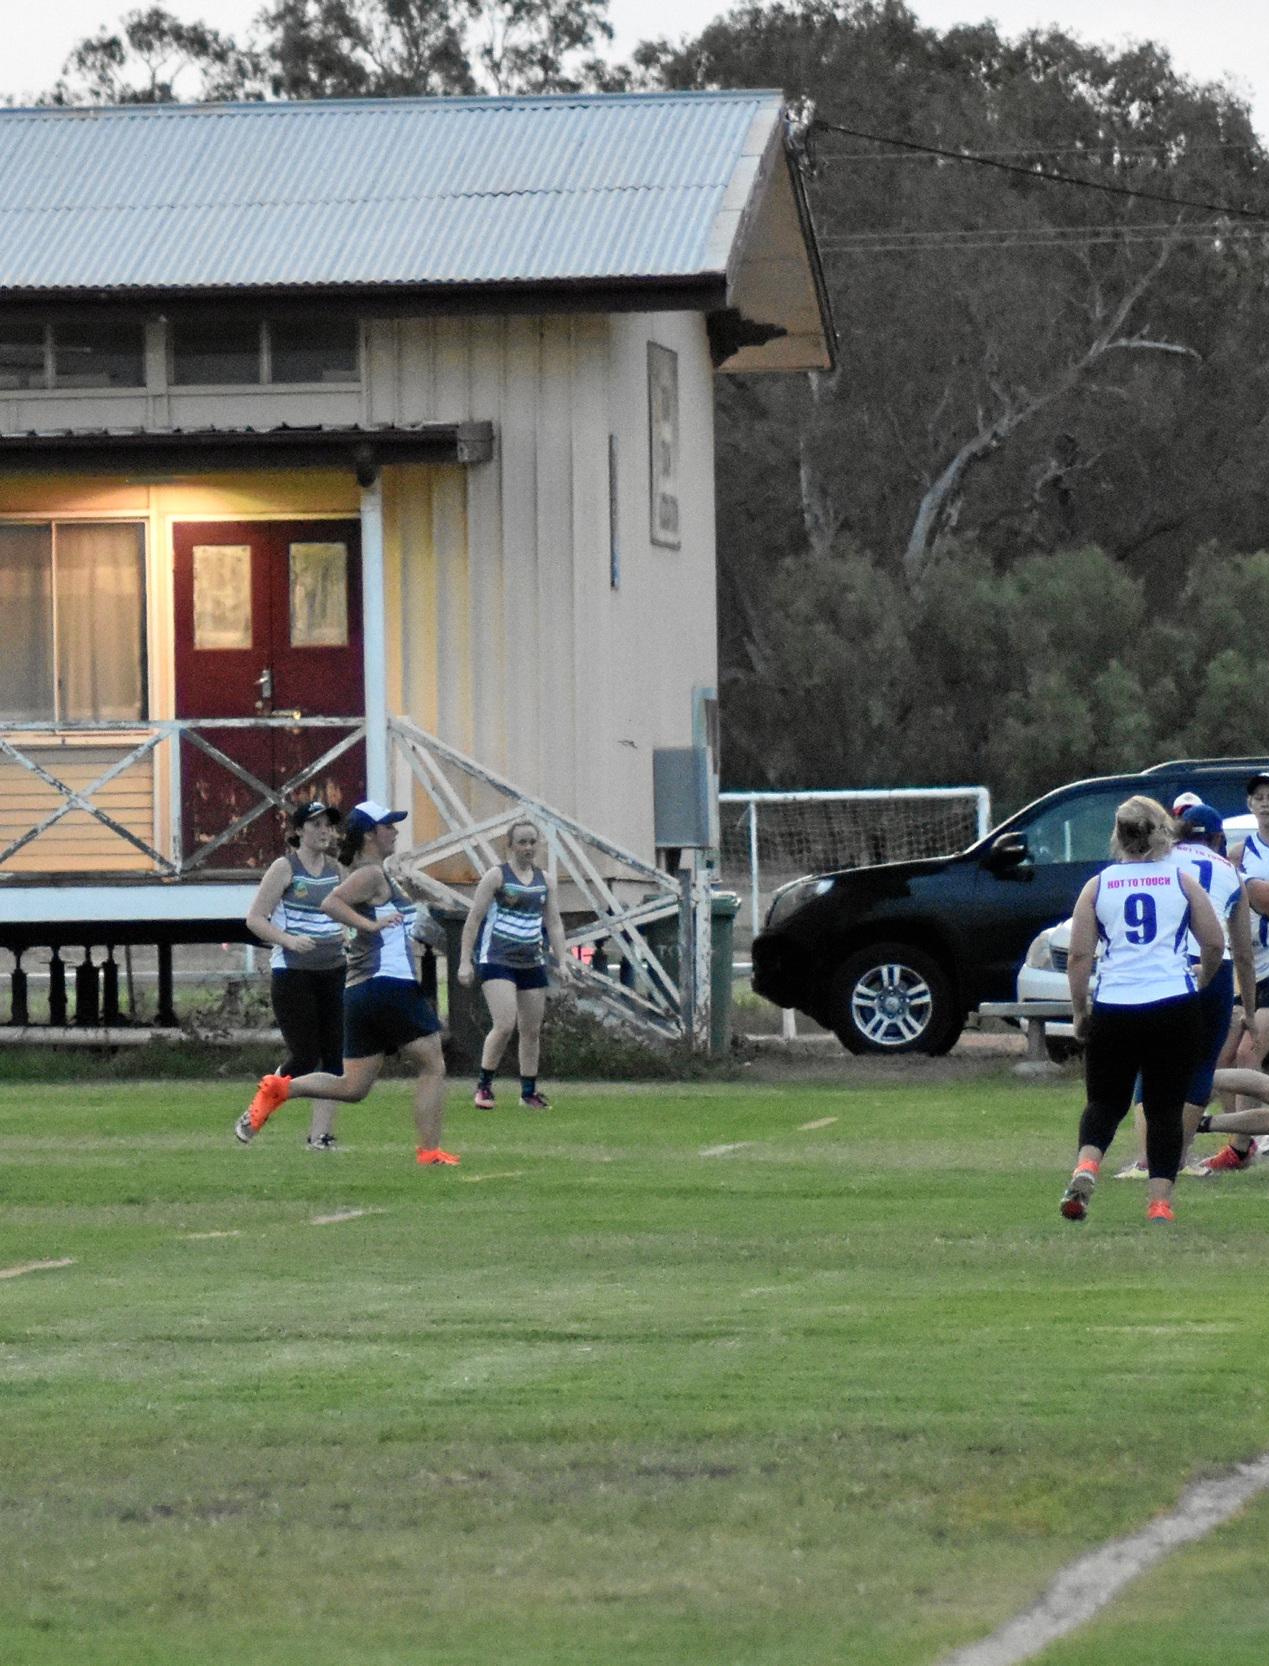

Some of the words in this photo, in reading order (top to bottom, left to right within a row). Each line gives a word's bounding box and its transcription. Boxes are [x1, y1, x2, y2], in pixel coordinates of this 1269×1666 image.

[1127, 878, 1138, 888] TO
[1140, 876, 1170, 886] TOUCH
[1123, 892, 1157, 944] 9
